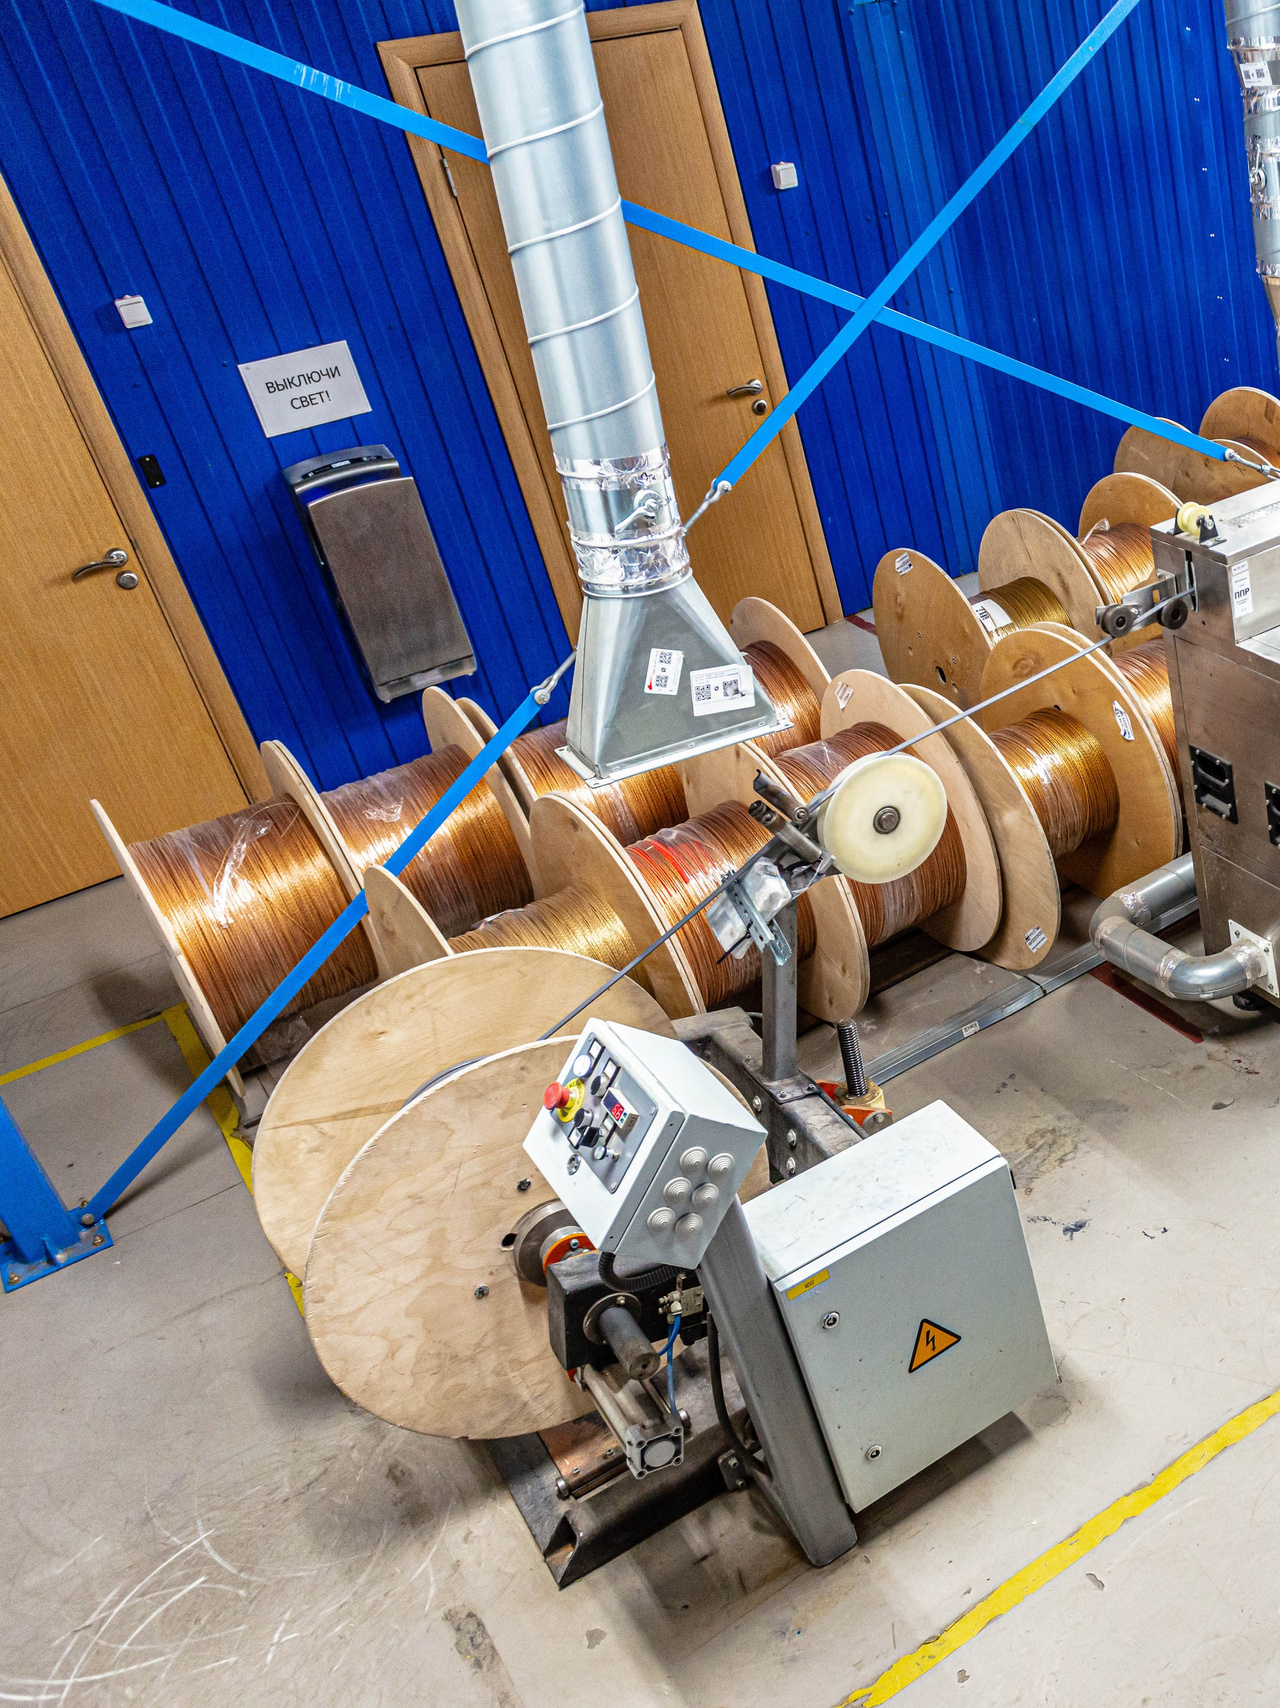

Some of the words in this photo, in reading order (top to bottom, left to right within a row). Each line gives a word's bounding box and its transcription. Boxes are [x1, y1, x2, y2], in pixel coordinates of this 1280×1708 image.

[265, 366, 341, 394] ВЫКЛЮЧИ
[290, 390, 331, 410] СВЕТ!
[1234, 587, 1250, 600] ППР
